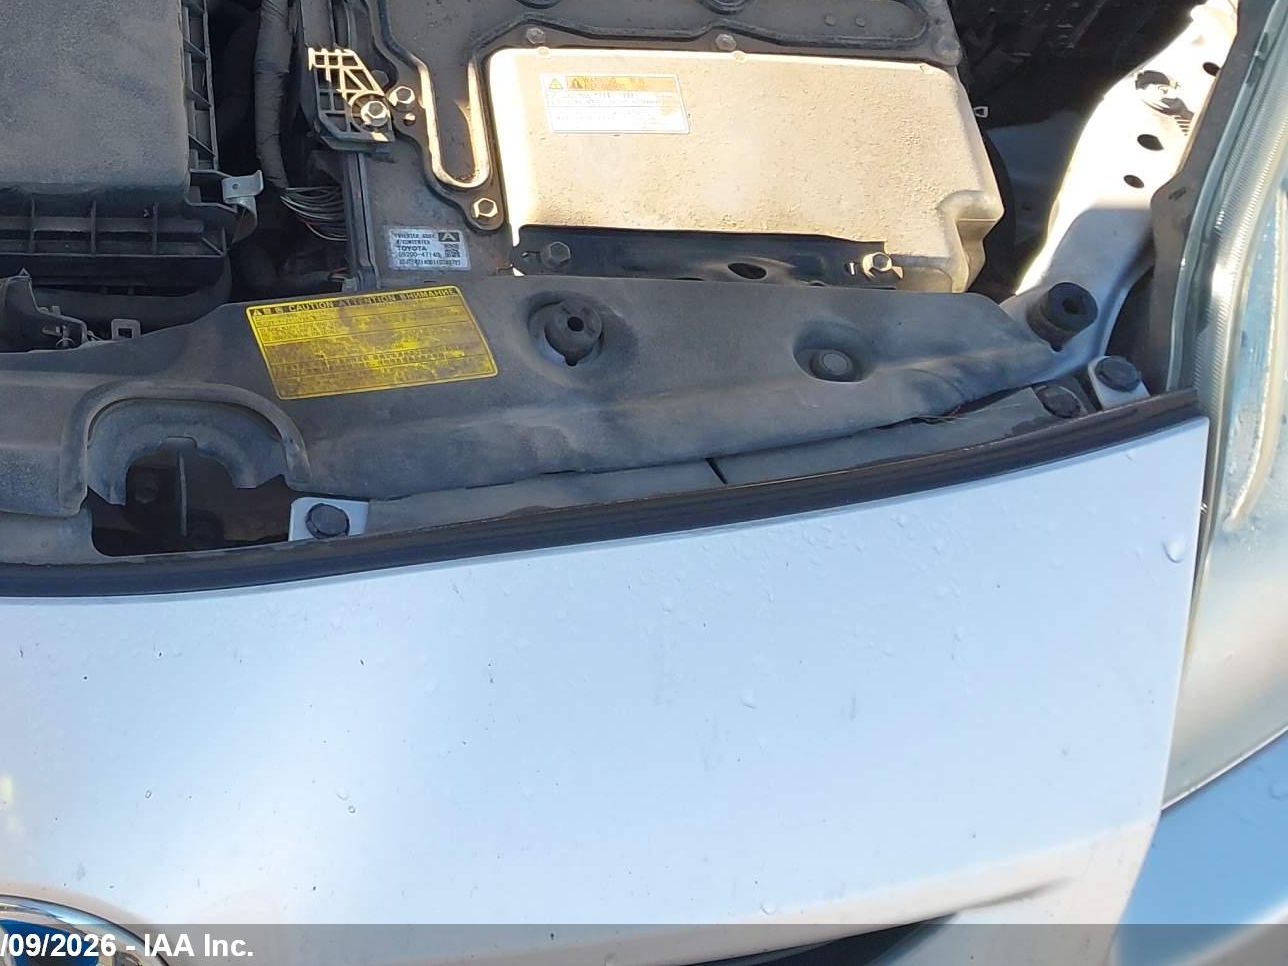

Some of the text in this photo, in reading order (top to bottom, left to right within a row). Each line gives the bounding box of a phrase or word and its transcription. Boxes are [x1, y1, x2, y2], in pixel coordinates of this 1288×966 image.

[441, 232, 457, 241] A
[288, 301, 335, 313] CAUTION
[338, 295, 396, 308] ATTENTION
[399, 288, 457, 301] ВНИМАНИЕ
